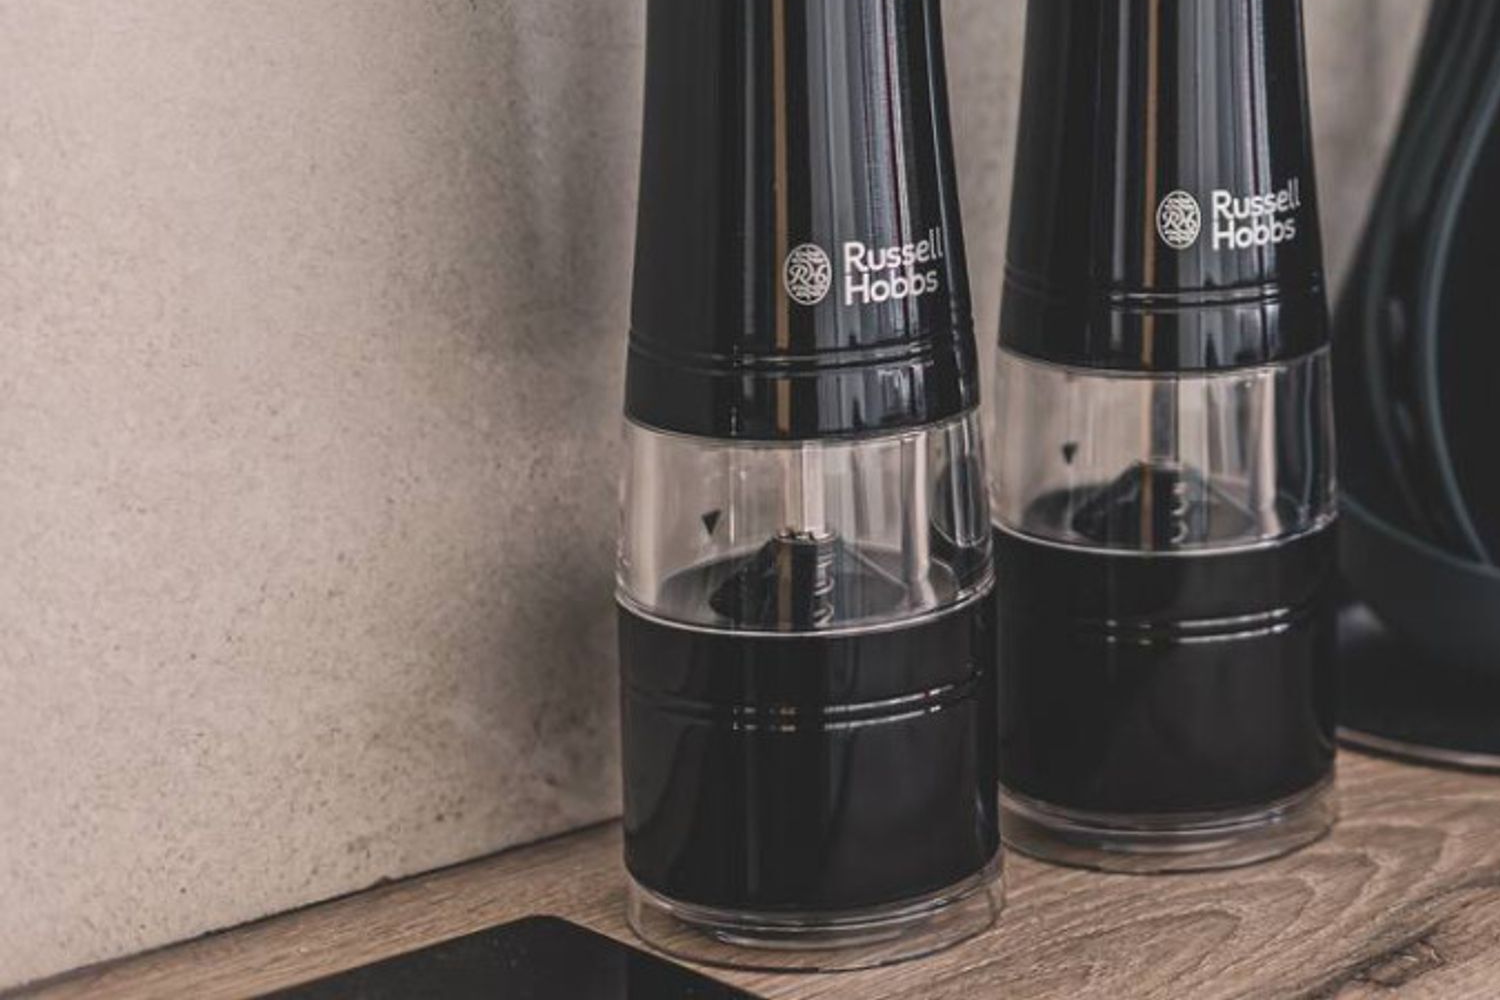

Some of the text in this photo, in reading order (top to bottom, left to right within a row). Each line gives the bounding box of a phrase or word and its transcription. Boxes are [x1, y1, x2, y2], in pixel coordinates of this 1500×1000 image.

[1212, 177, 1301, 220] Russell
[843, 226, 943, 273] Russell
[1212, 213, 1296, 250] Hobbs
[845, 266, 939, 305] Hobbs
